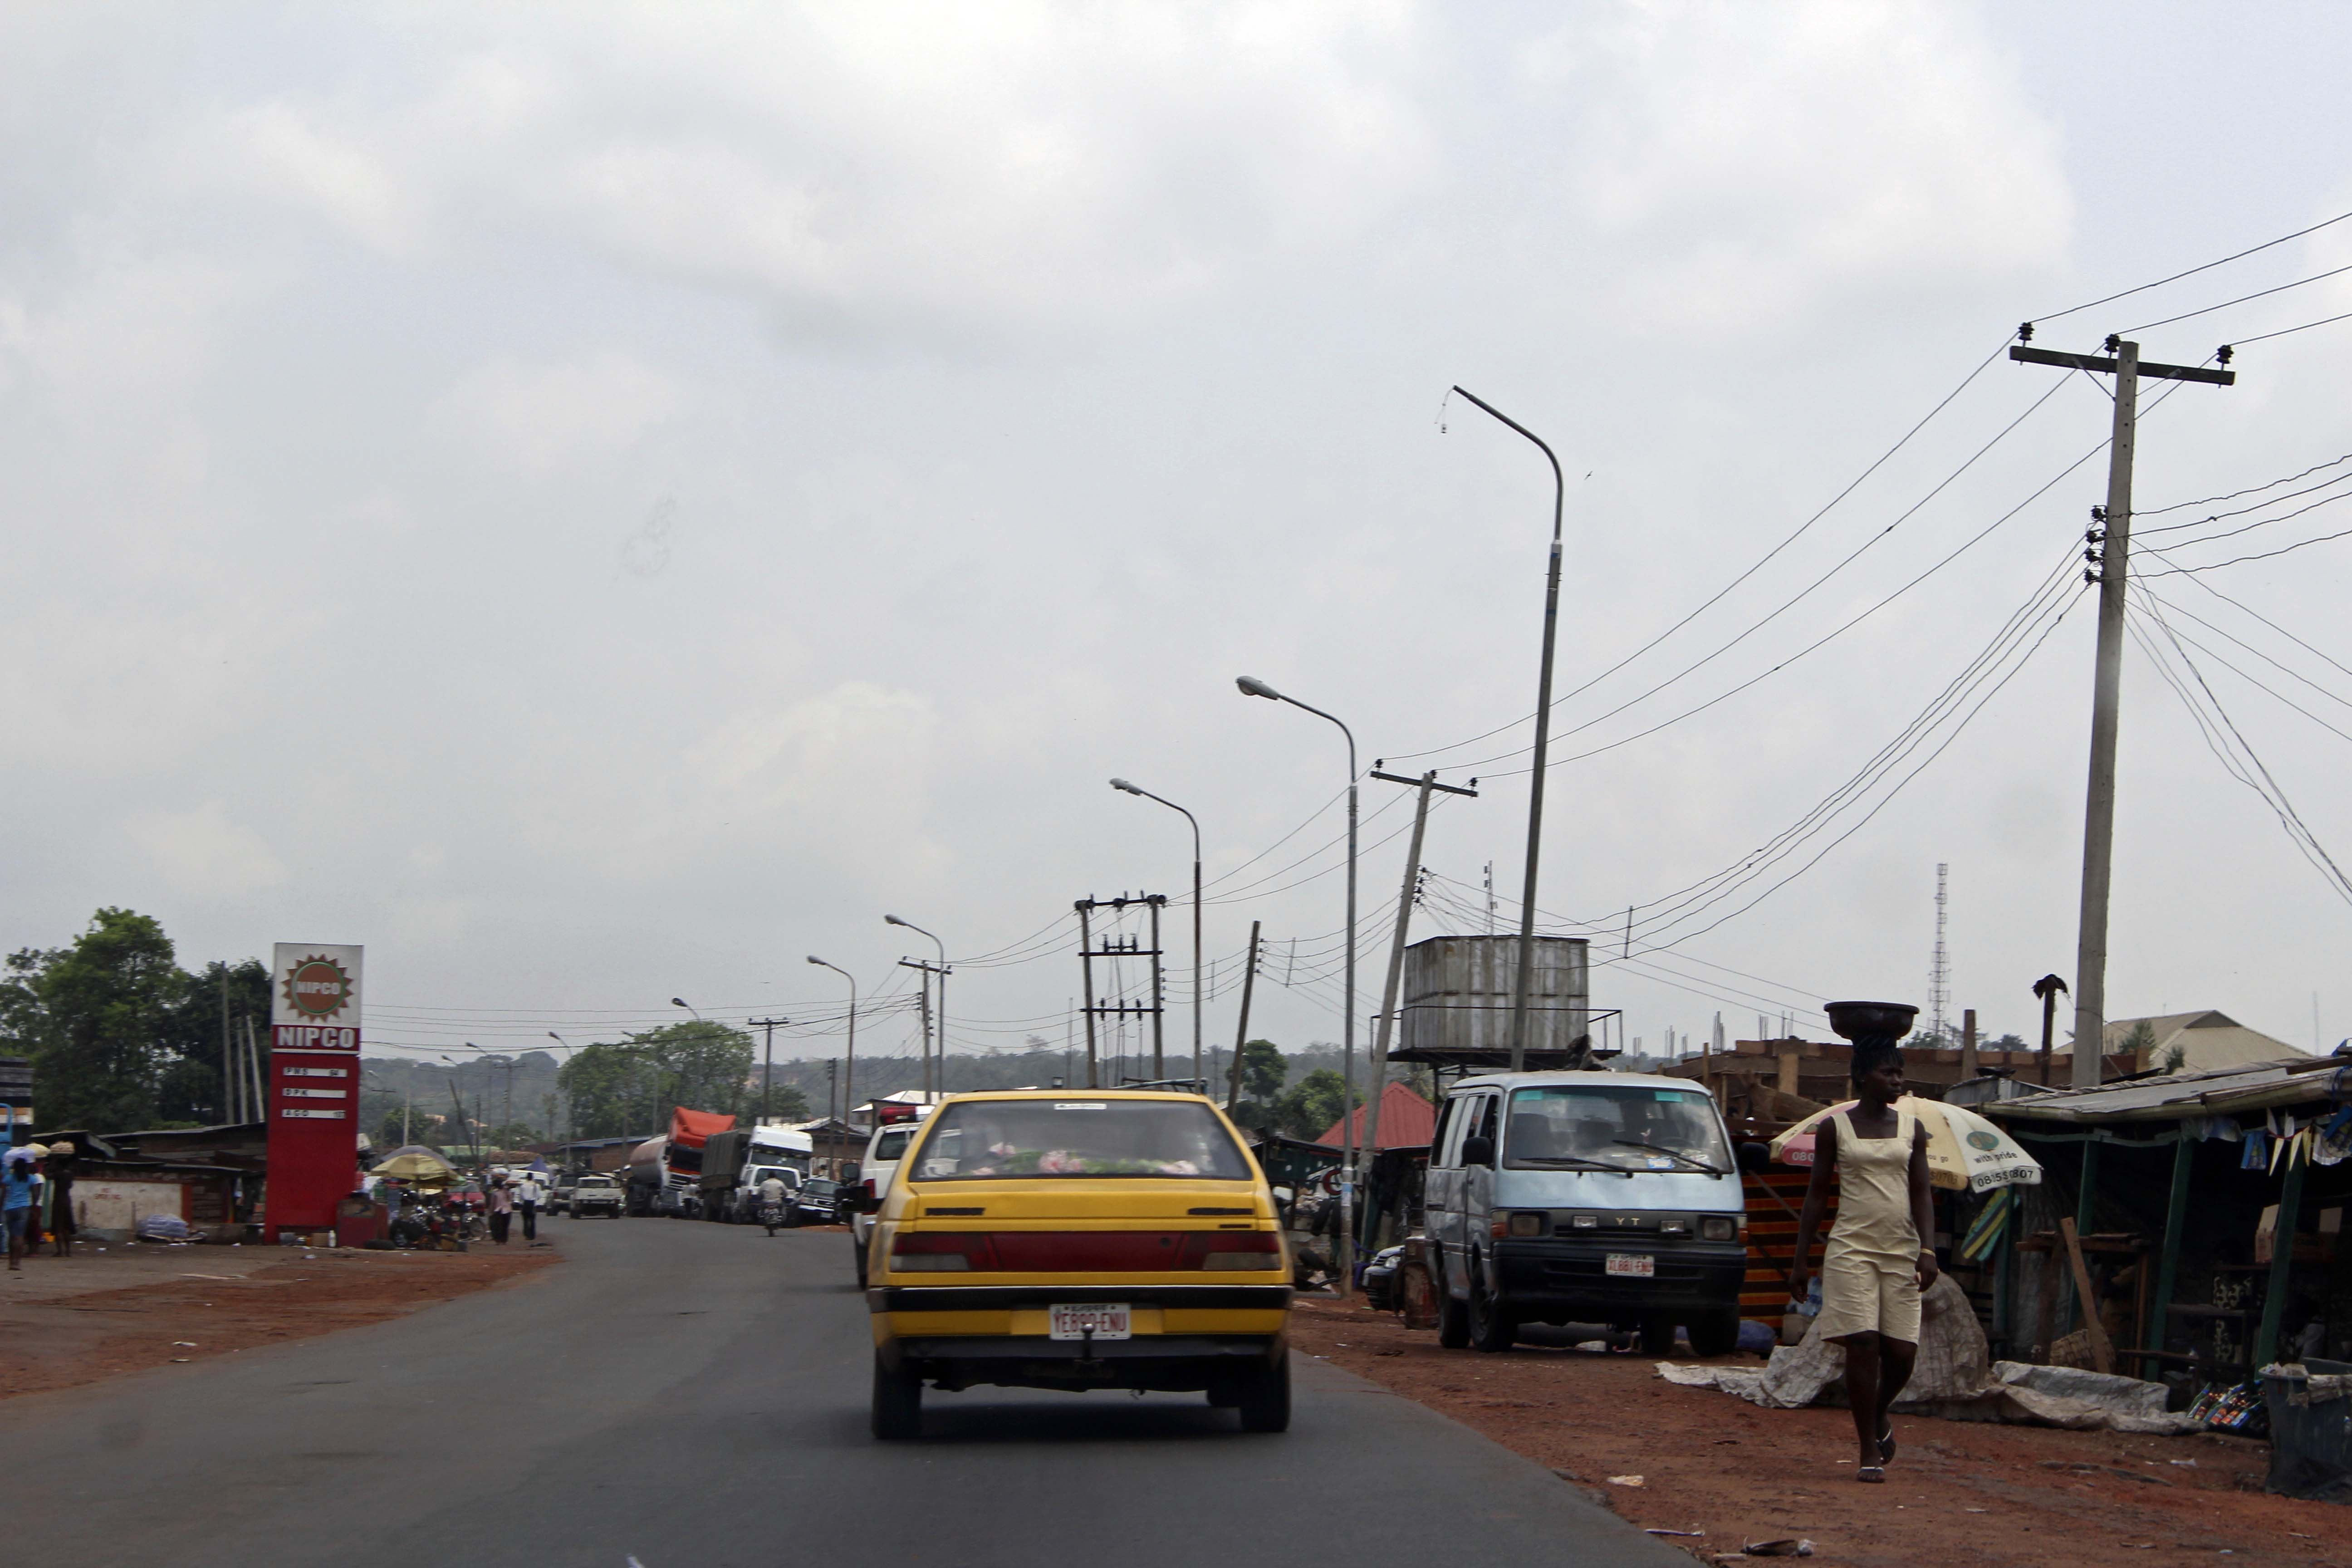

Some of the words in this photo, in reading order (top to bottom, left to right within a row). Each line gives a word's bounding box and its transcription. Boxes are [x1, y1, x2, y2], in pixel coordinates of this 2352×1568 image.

[297, 981, 340, 995] NIPCO
[278, 1027, 355, 1049] NIPCO
[1974, 1154, 1994, 1163] with
[1994, 1151, 2018, 1161] pride
